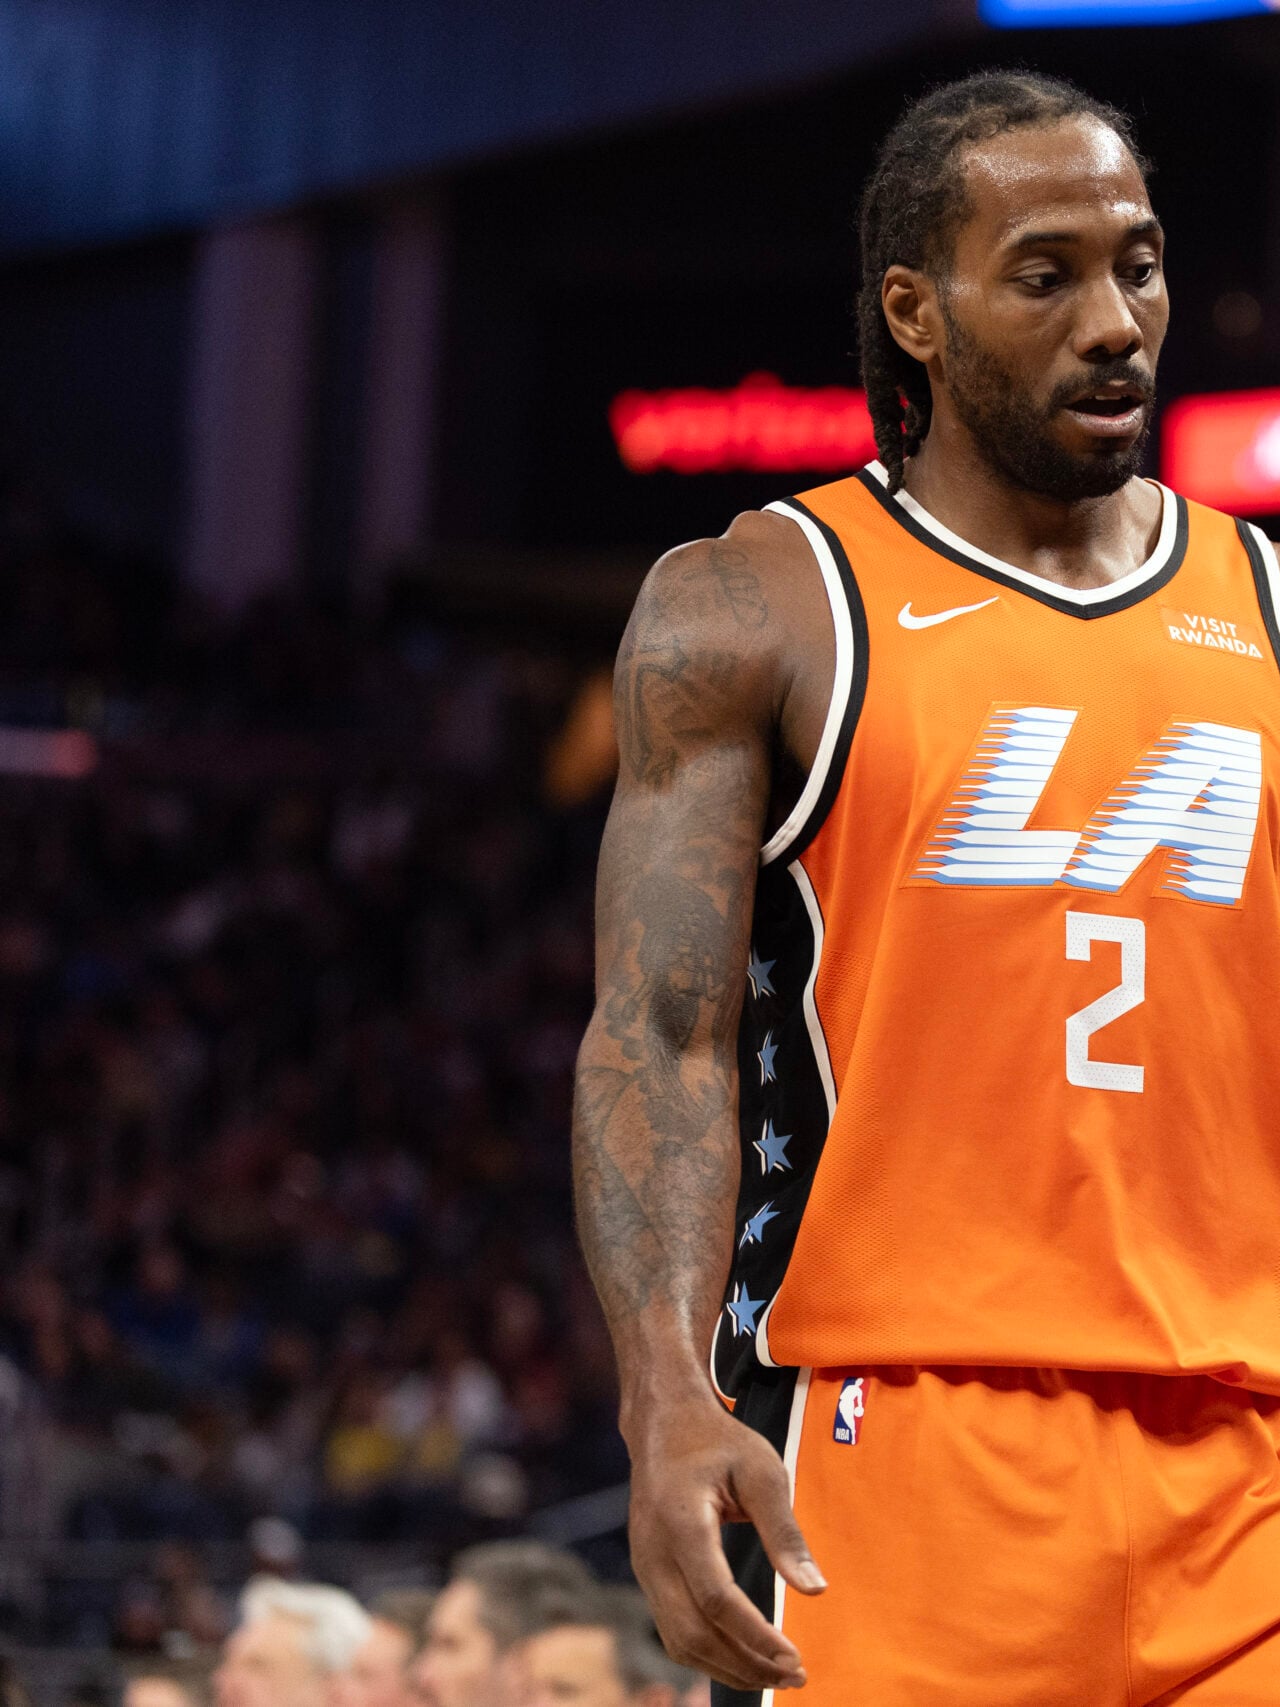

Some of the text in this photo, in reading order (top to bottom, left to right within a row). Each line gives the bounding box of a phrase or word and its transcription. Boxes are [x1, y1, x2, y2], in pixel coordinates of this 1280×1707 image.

[1168, 625, 1263, 658] RWANDA
[1183, 613, 1236, 637] VISIT
[909, 706, 1263, 905] LA
[1066, 910, 1146, 1093] 2
[835, 1427, 850, 1441] NBA
